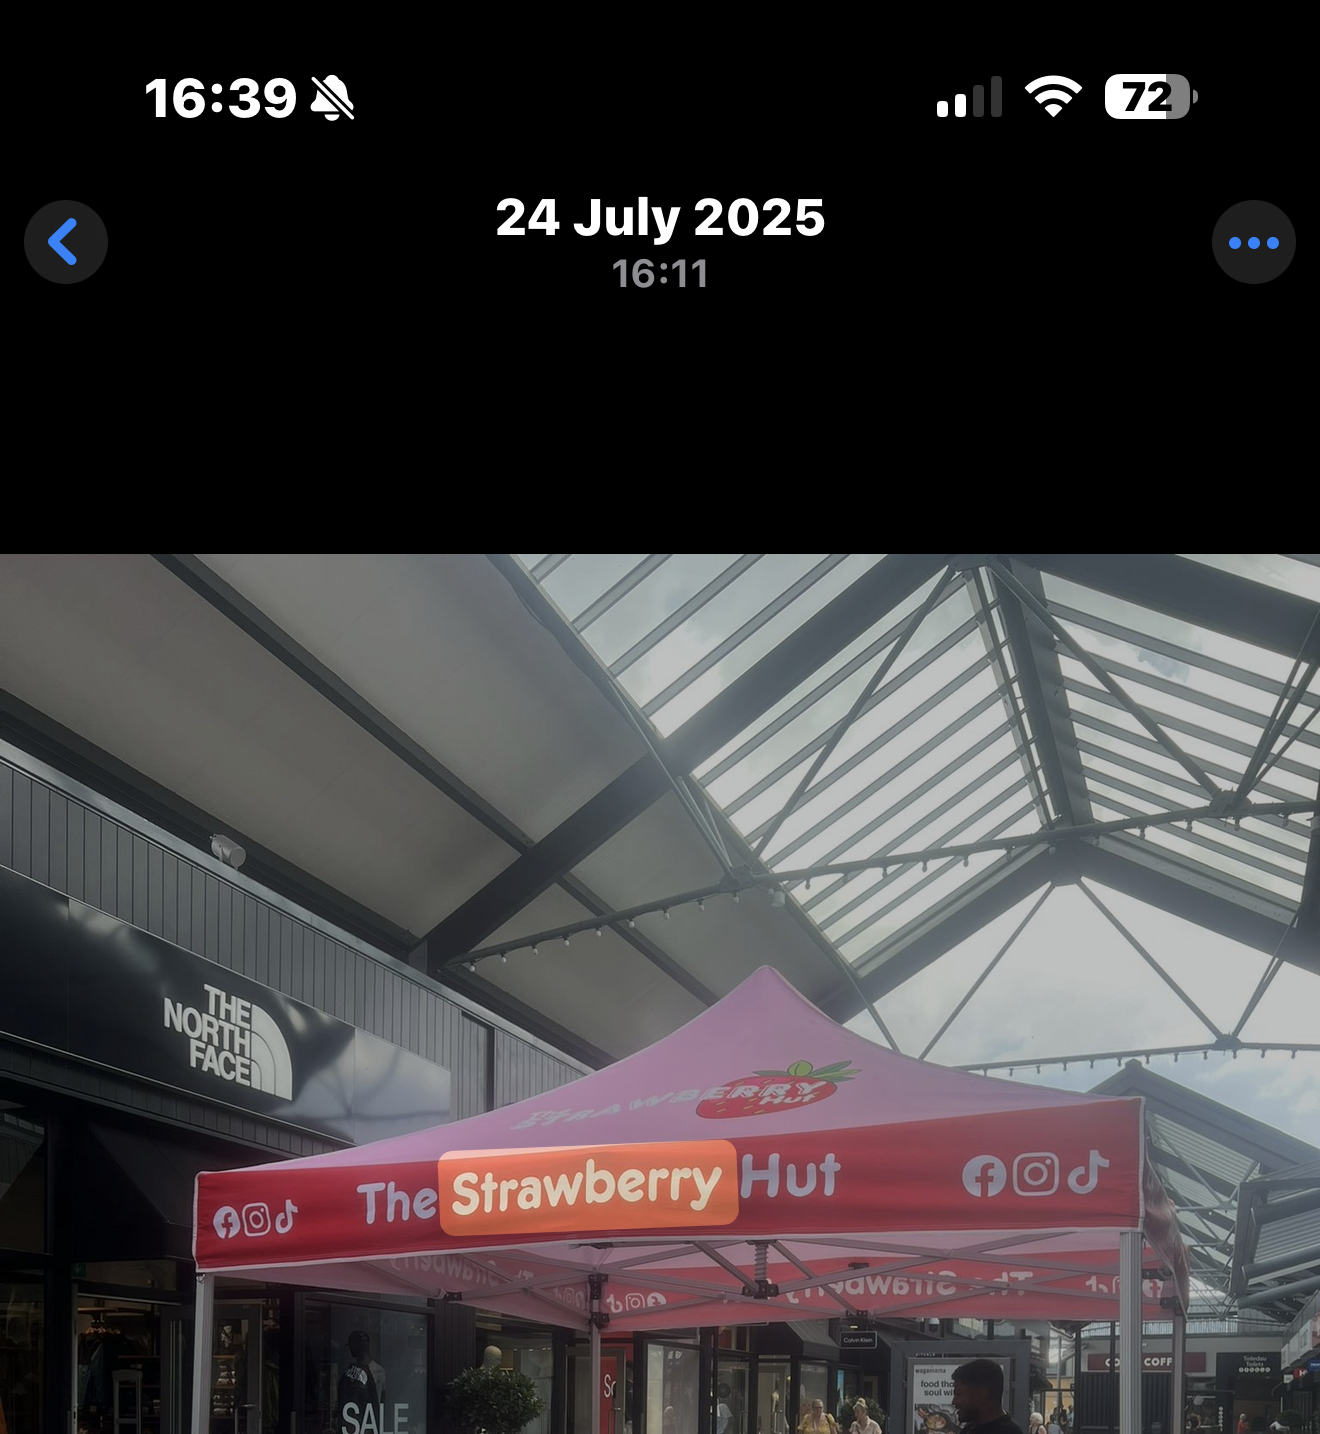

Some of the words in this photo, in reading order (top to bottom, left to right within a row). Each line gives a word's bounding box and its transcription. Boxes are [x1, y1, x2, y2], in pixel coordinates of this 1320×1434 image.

[163, 997, 251, 1059] NORTH
[203, 983, 251, 1030] THE
[189, 1038, 251, 1087] FACE
[509, 1080, 829, 1131] STRAWBERRY
[356, 1181, 438, 1225] The
[451, 1158, 723, 1217] Strawberry
[740, 1152, 842, 1200] Hut
[920, 1380, 939, 1388] food
[924, 1388, 942, 1396] soul
